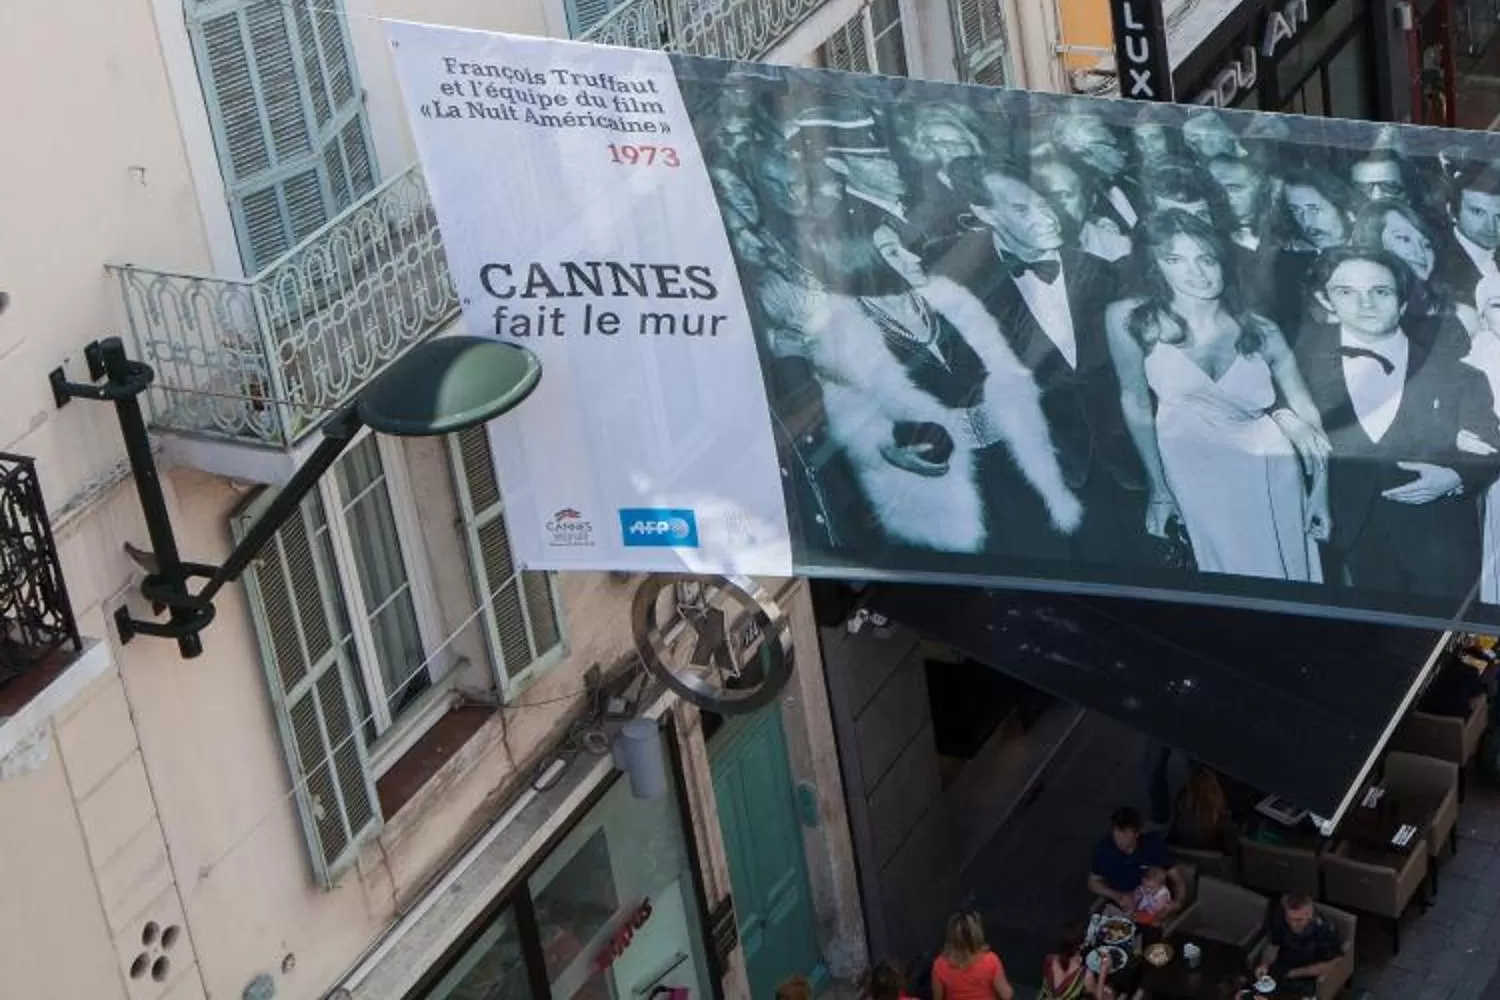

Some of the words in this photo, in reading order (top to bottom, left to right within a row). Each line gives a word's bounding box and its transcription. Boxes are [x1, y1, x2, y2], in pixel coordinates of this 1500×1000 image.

[1123, 1, 1154, 97] LUX
[442, 56, 547, 86] François
[551, 68, 659, 94] Truffaut
[440, 81, 465, 97] et
[575, 90, 609, 109] du
[611, 95, 666, 115] film
[467, 101, 519, 121] Nuit
[608, 143, 682, 168] 1973
[479, 261, 719, 301] CANNES
[493, 304, 565, 337] fait
[583, 303, 621, 336] le
[638, 312, 728, 337] mur
[545, 521, 593, 533] CANNES
[629, 520, 670, 536] AFP
